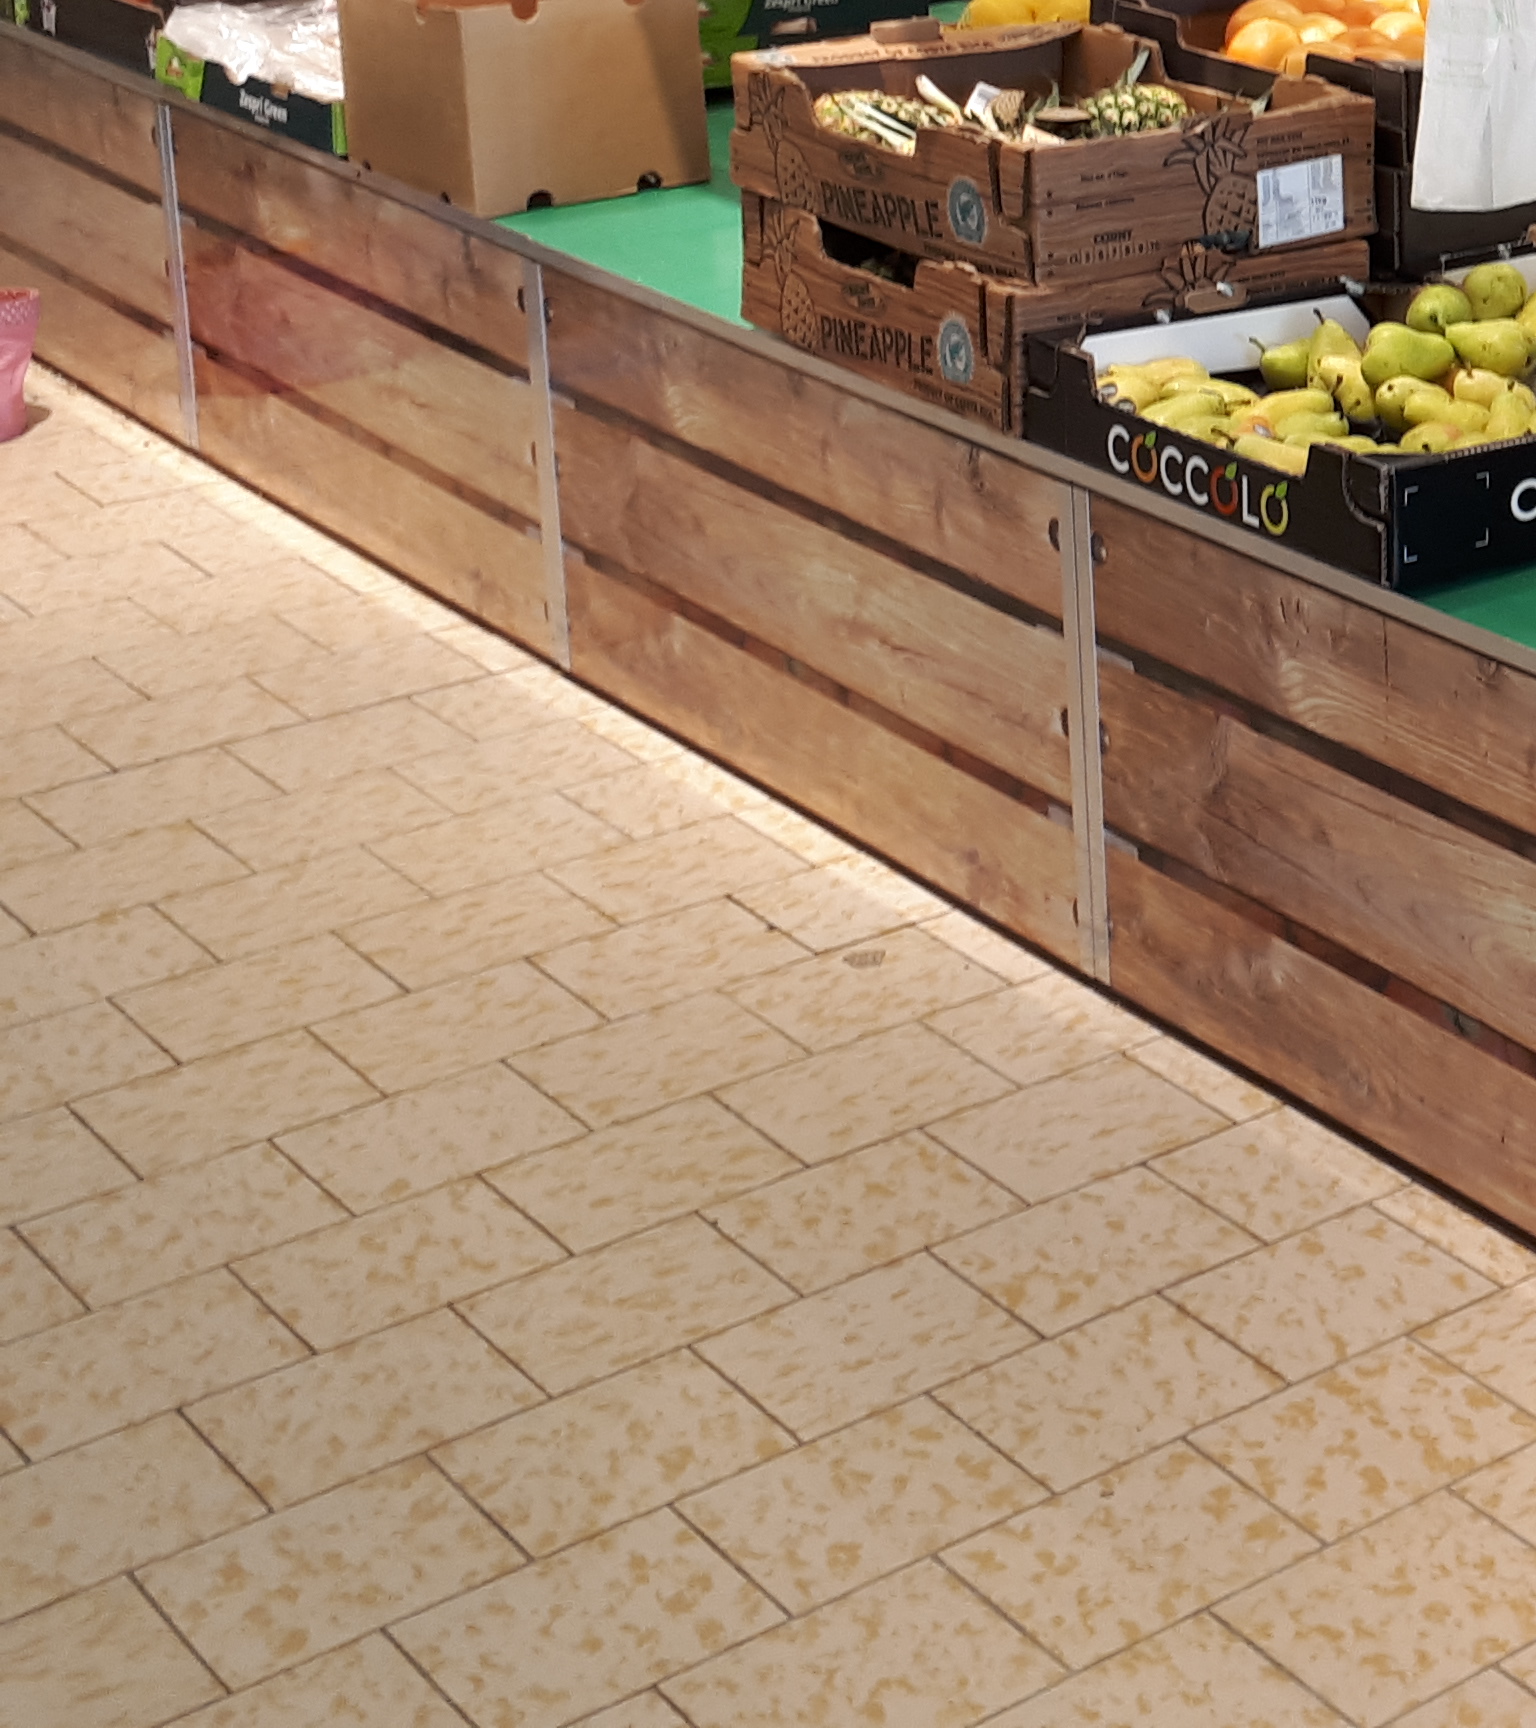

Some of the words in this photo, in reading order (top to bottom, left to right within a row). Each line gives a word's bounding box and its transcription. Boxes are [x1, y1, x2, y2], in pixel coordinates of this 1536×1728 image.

[820, 179, 943, 239] PINEAPPLE
[820, 315, 933, 376] PINEAPPLE
[1107, 426, 1290, 535] COCCOLO
